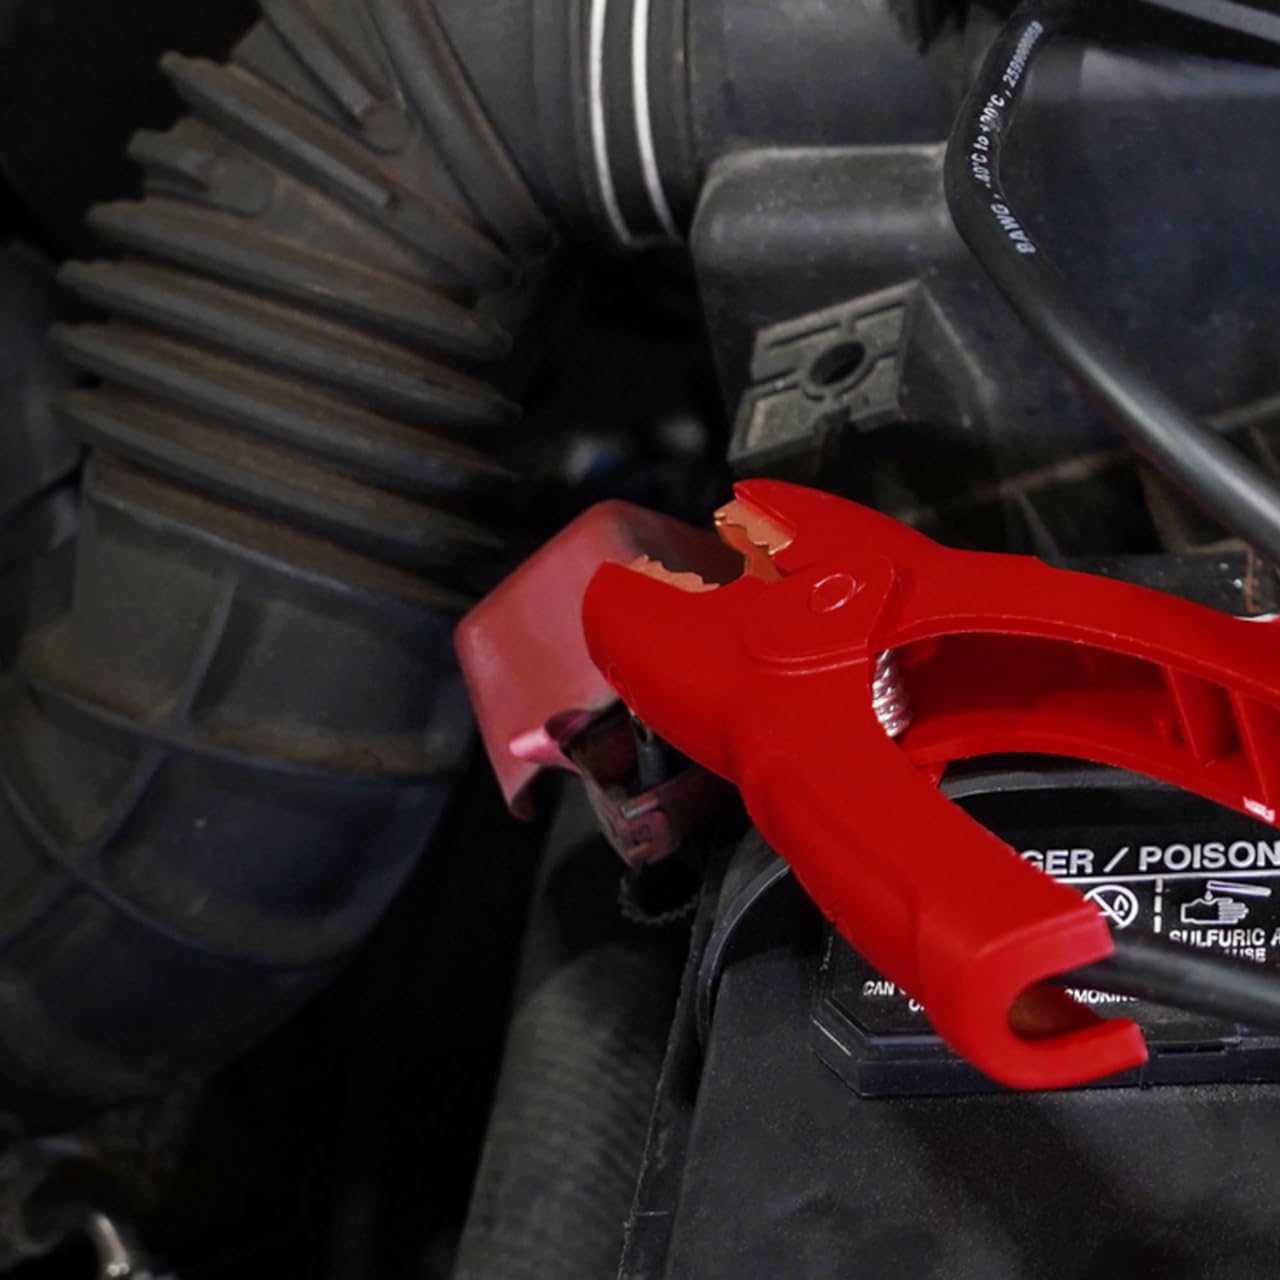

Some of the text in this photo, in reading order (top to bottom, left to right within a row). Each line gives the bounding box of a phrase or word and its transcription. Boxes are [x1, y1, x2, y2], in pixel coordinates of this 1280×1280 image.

[973, 135, 990, 152] to
[990, 202, 1036, 255] 8AWG
[1020, 847, 1095, 876] GER
[1168, 927, 1265, 948] SULFURIC
[863, 980, 895, 996] CAN
